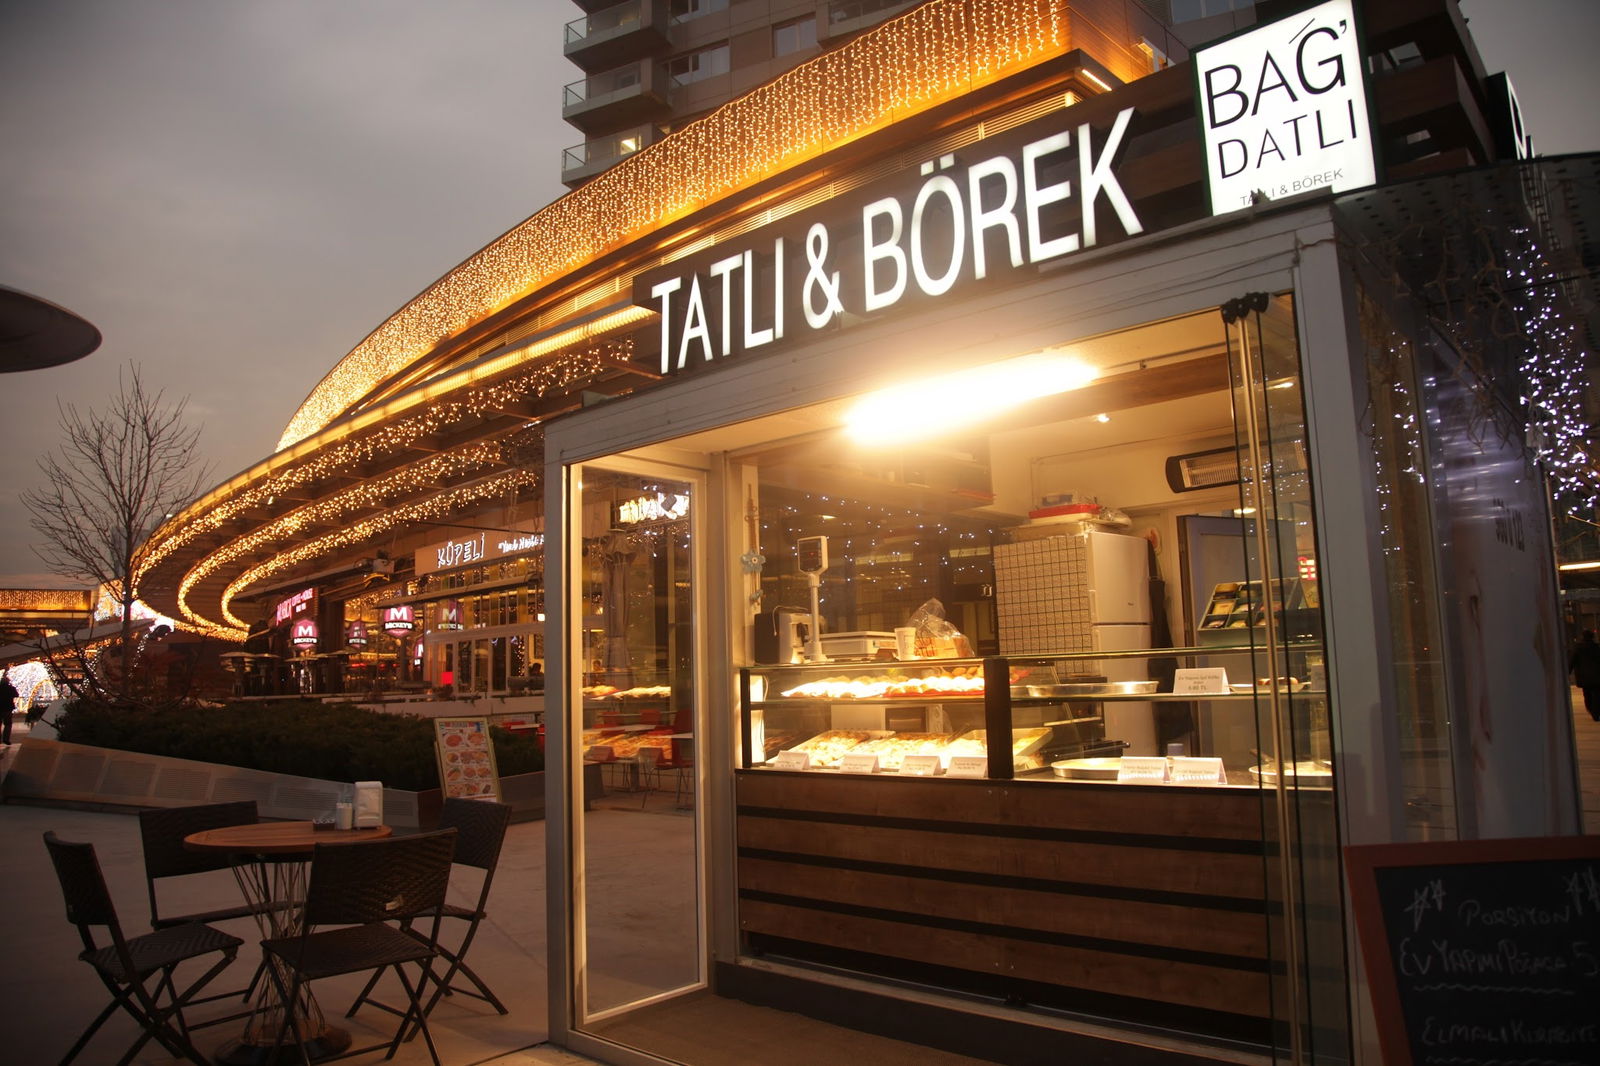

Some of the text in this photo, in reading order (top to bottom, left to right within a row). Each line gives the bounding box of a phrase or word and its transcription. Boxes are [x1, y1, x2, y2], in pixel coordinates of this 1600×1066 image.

[1217, 98, 1357, 179] DATLI
[1292, 167, 1344, 192] BÖREK
[651, 106, 1144, 375] TATLI & BÖREK
[390, 607, 408, 620] M
